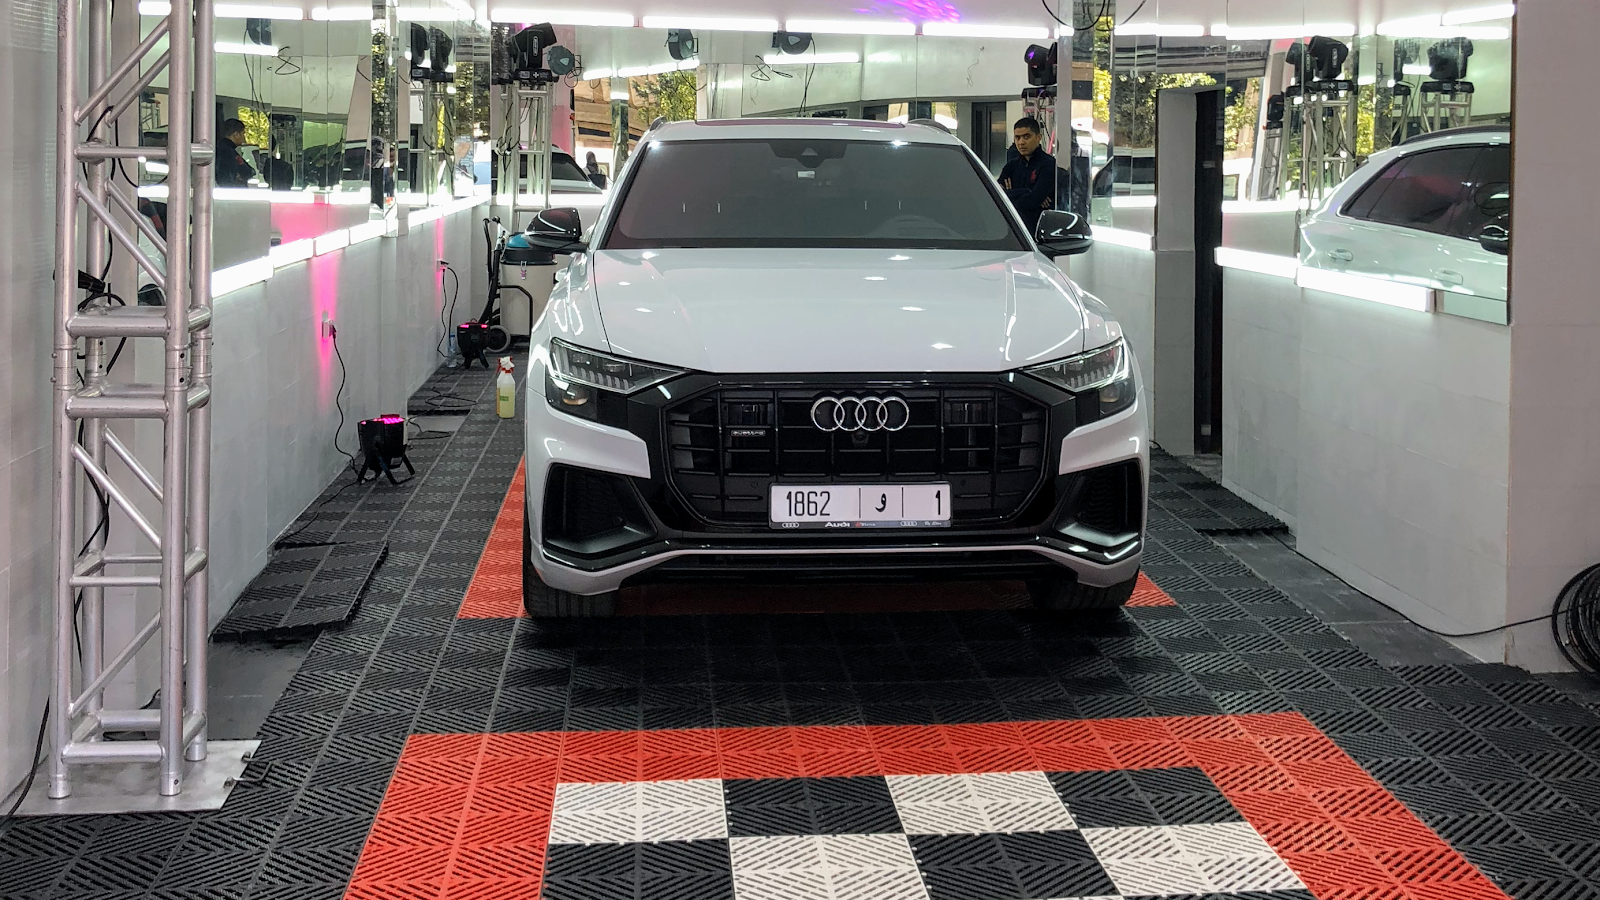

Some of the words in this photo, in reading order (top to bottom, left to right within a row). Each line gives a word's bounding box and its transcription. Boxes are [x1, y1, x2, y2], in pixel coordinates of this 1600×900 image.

[786, 491, 831, 517] 1862
[875, 493, 887, 512] و
[935, 490, 941, 516] 1
